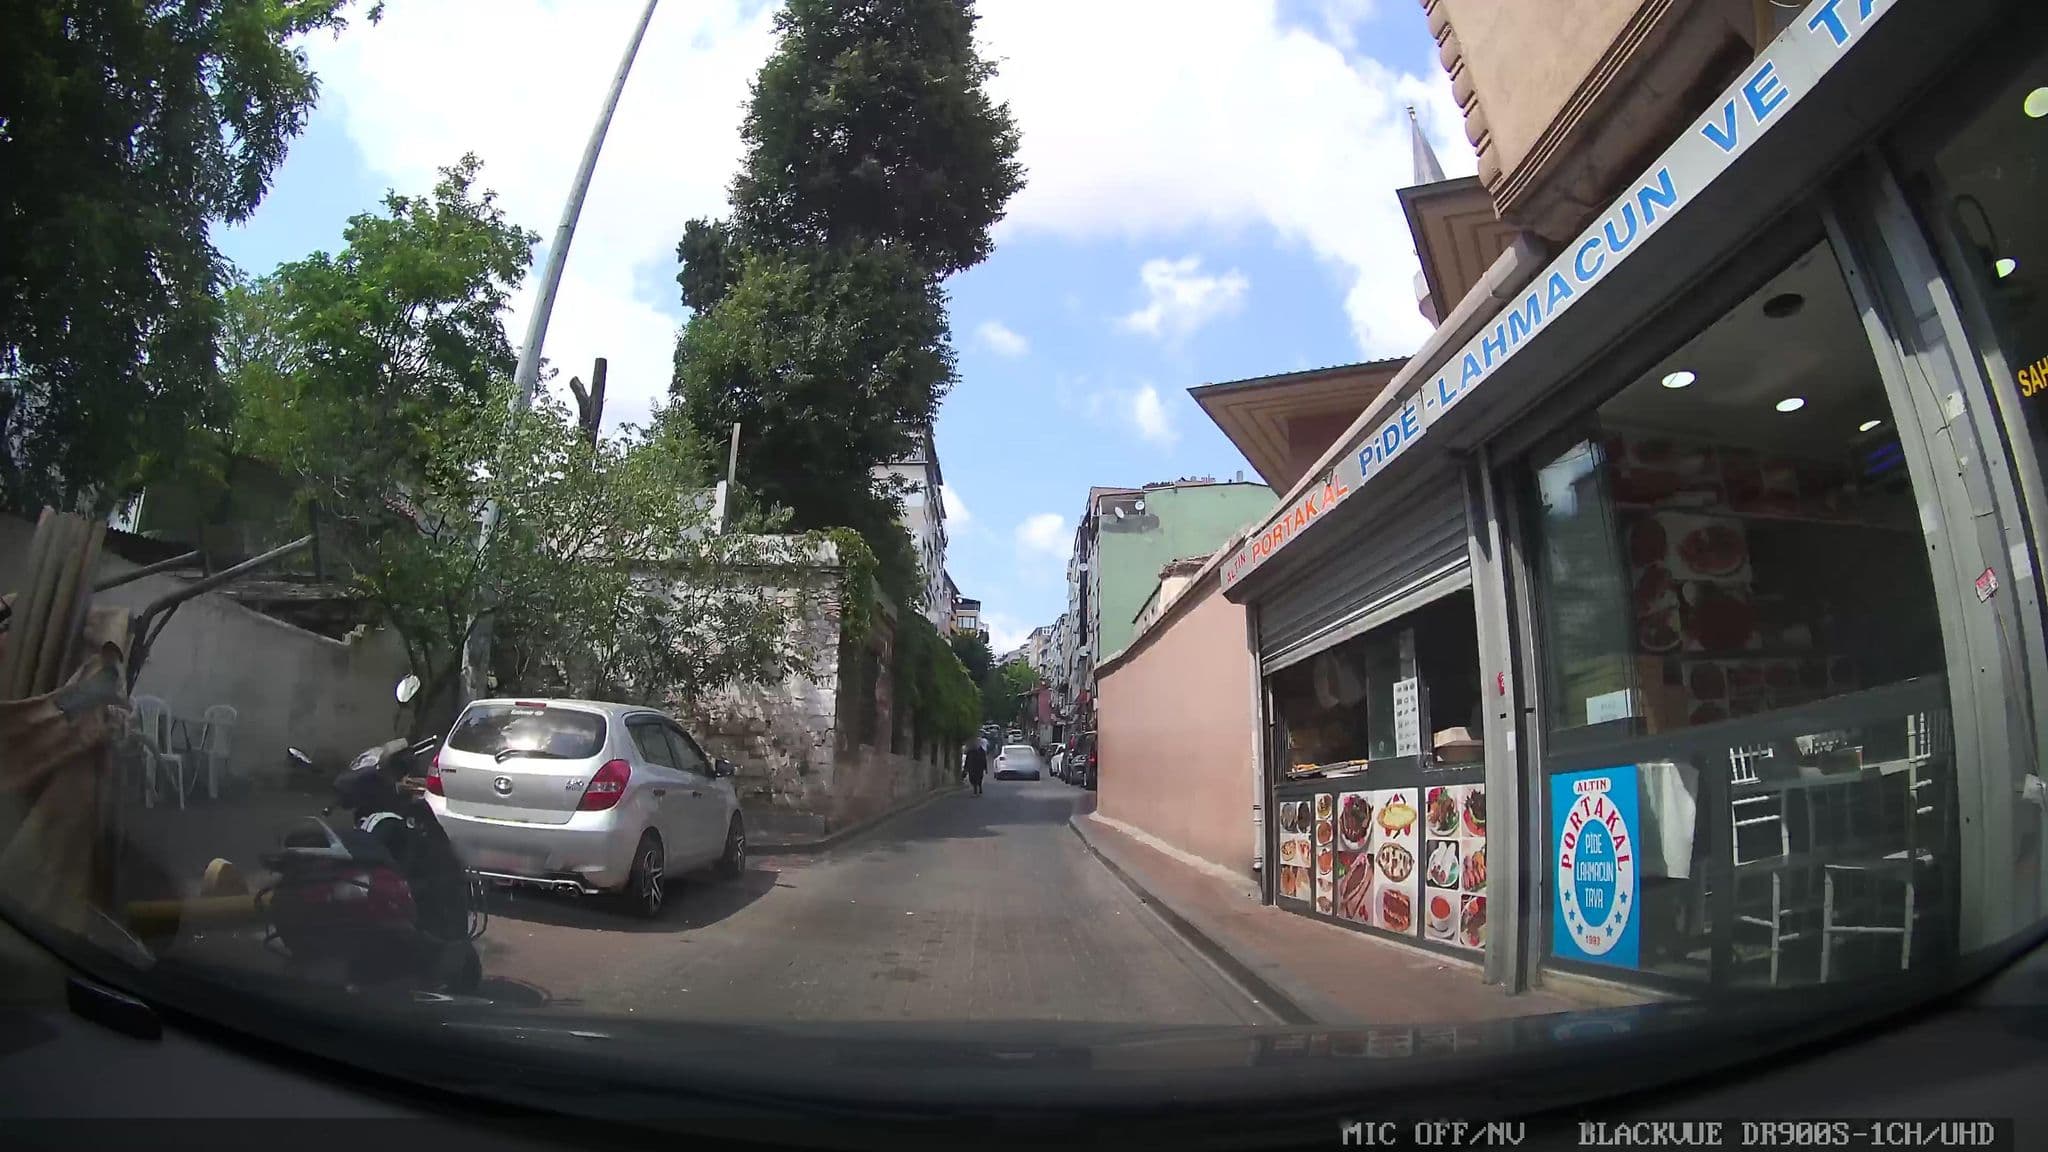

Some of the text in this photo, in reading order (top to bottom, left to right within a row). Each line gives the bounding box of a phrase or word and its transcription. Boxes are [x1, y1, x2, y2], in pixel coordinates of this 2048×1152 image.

[1251, 474, 1349, 563] PORTAKAL
[1700, 59, 1790, 154] VE
[1577, 779, 1607, 792] ALTIN
[1561, 796, 1630, 872] PORTAKAL
[1576, 861, 1614, 882] LAHMACUN
[1585, 887, 1604, 909] TAVA
